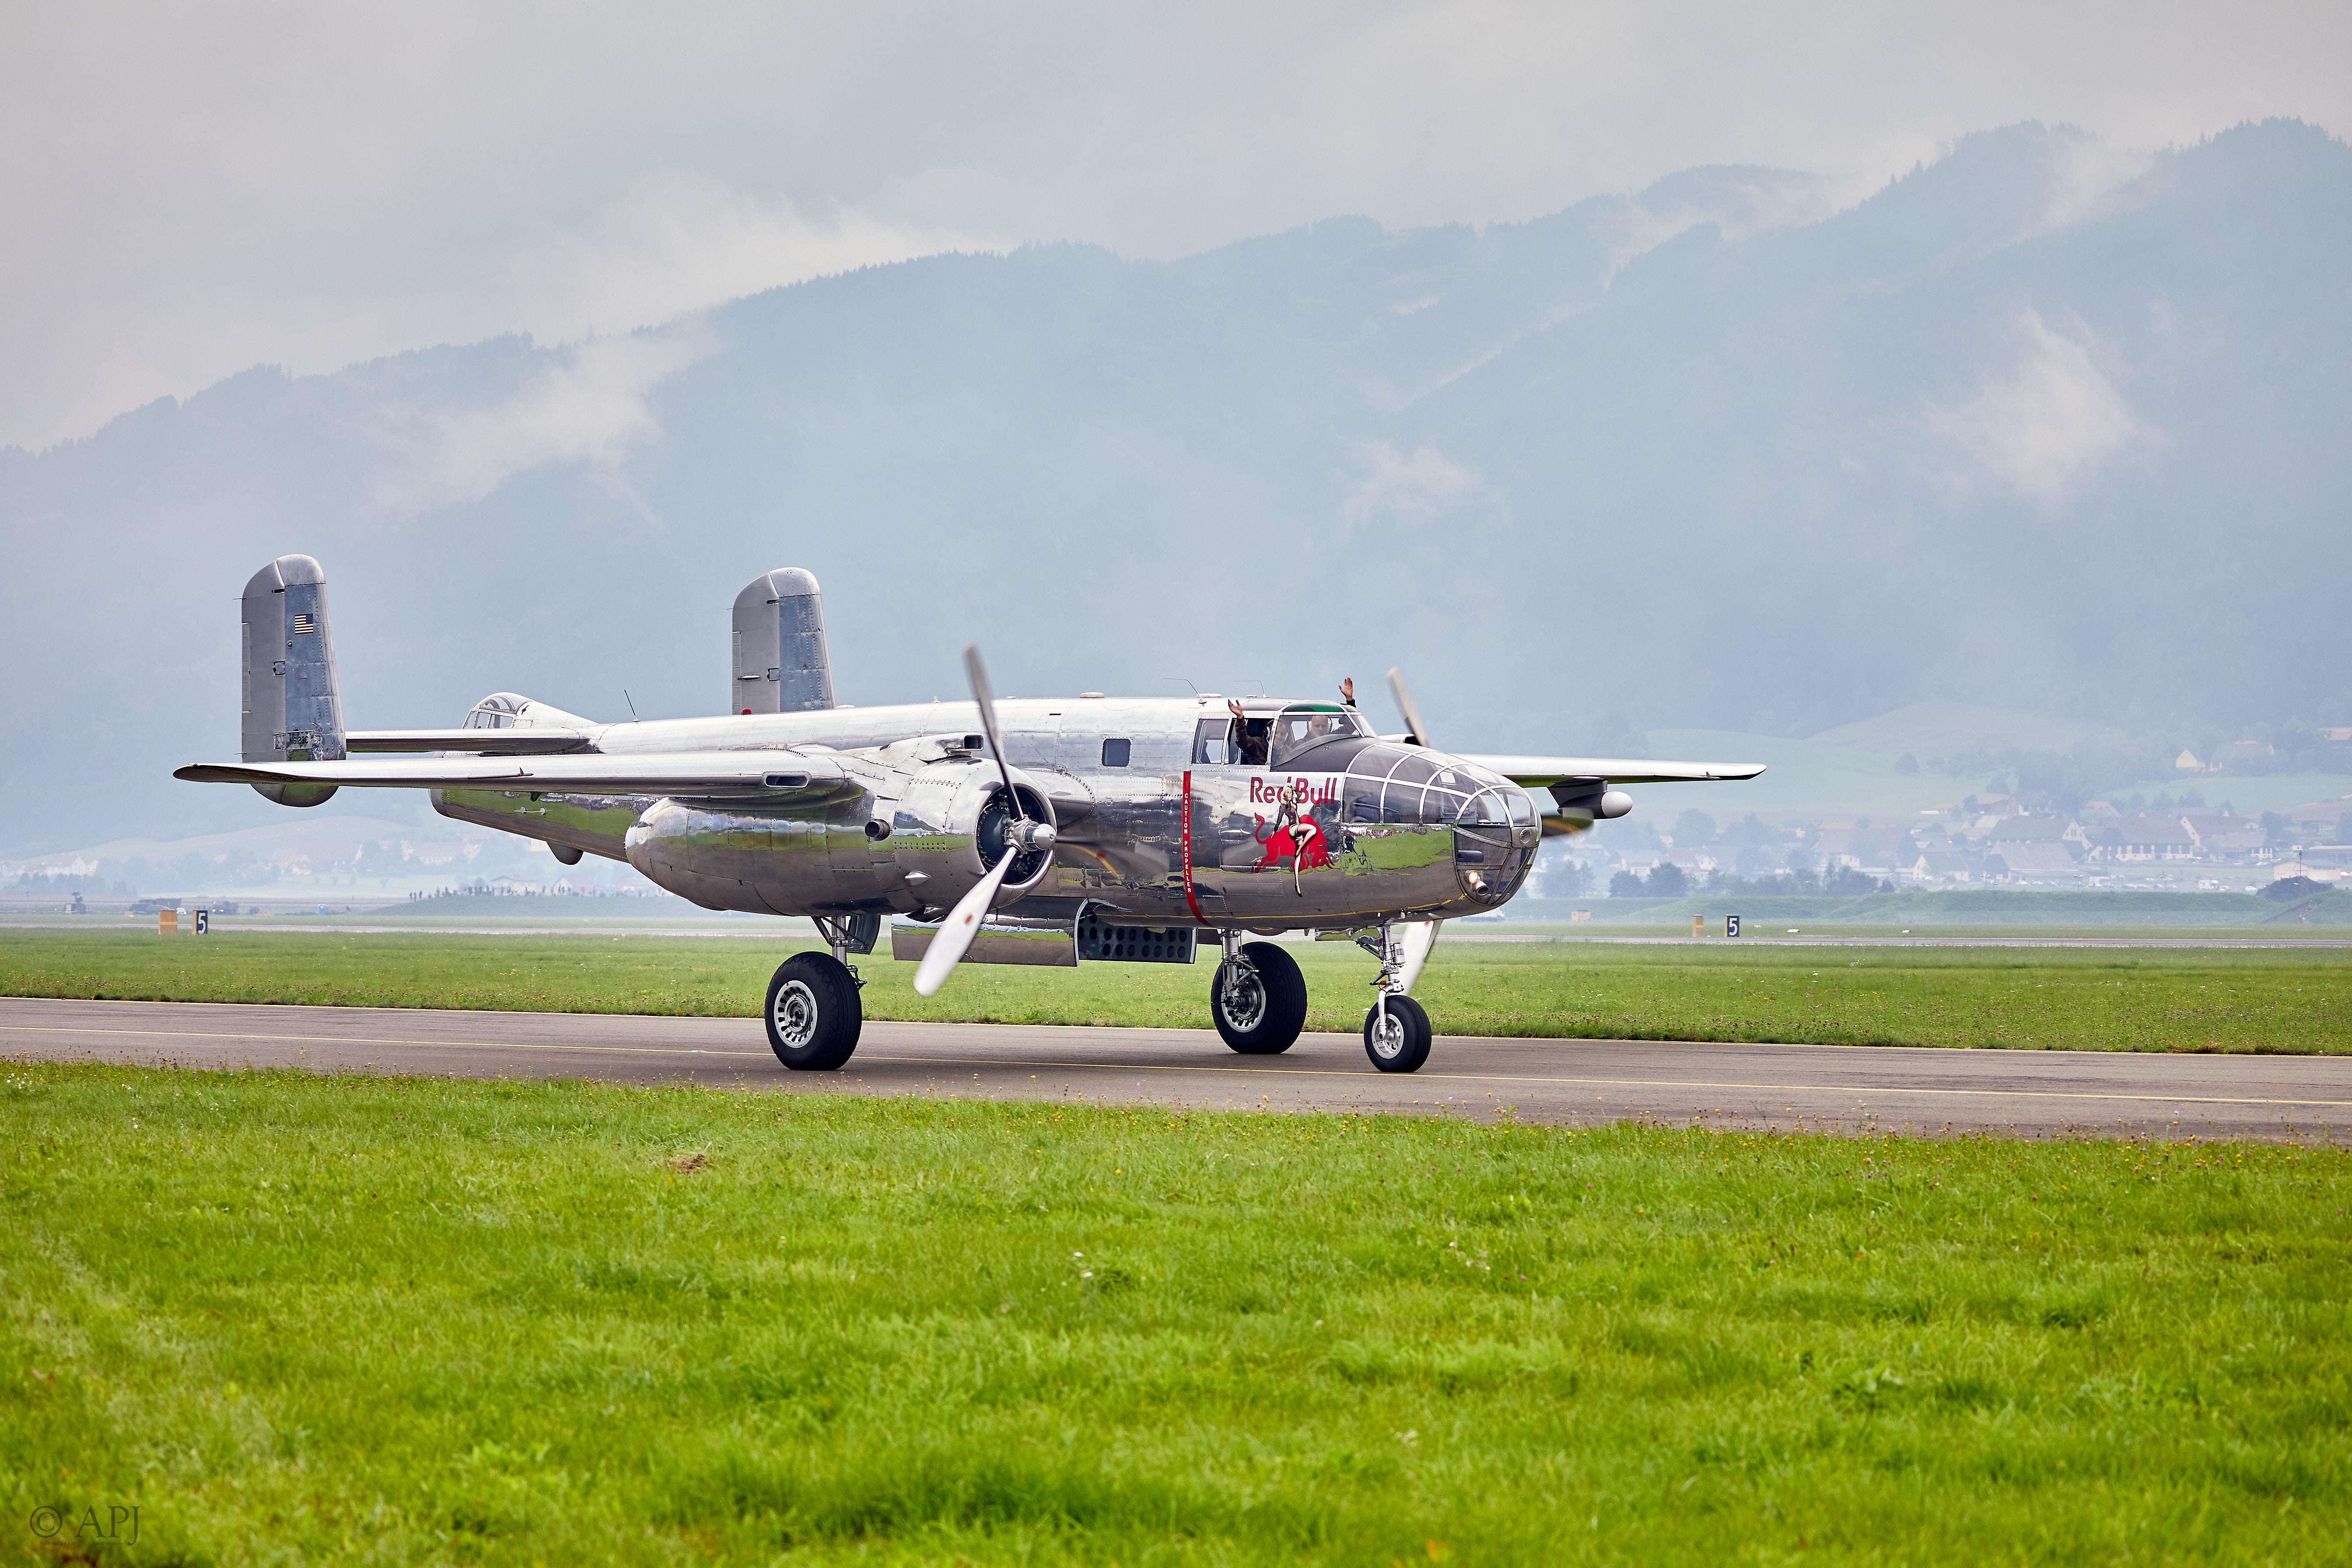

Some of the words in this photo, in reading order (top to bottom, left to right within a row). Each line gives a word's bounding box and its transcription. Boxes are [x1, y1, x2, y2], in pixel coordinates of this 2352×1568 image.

[289, 736, 308, 745] N6123C
[1295, 777, 1337, 804] Bull
[198, 913, 206, 934] 5
[1729, 917, 1738, 936] 5
